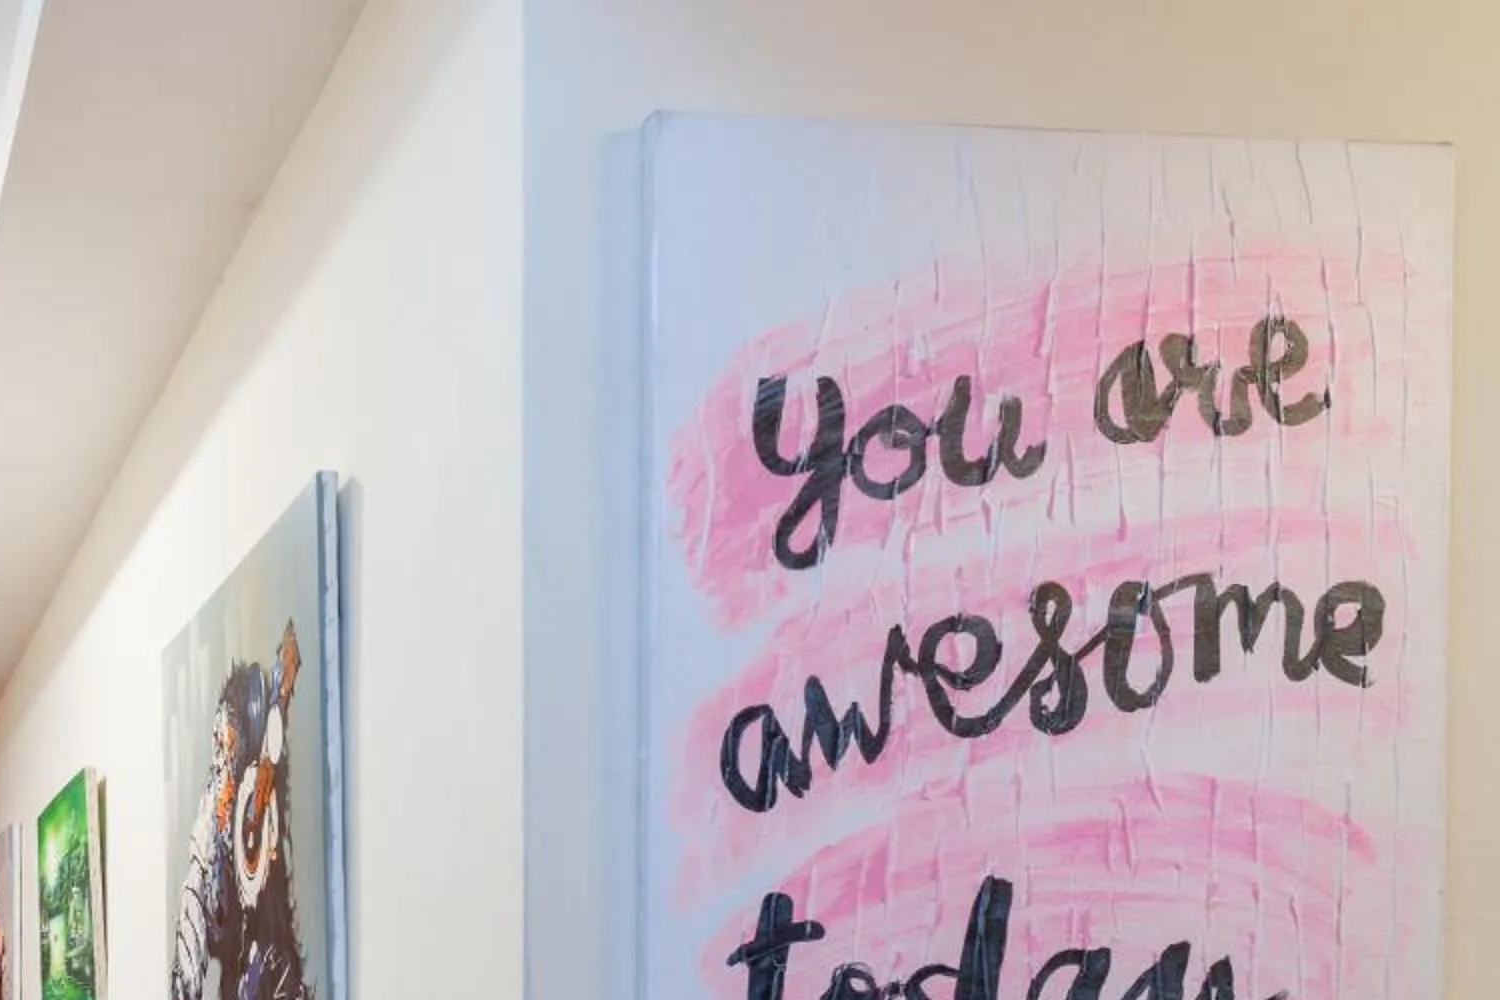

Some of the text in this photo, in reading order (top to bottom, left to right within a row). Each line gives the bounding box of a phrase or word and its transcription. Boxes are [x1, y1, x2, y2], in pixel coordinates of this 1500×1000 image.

[752, 314, 1332, 571] you are
[720, 573, 1386, 812] awesome
